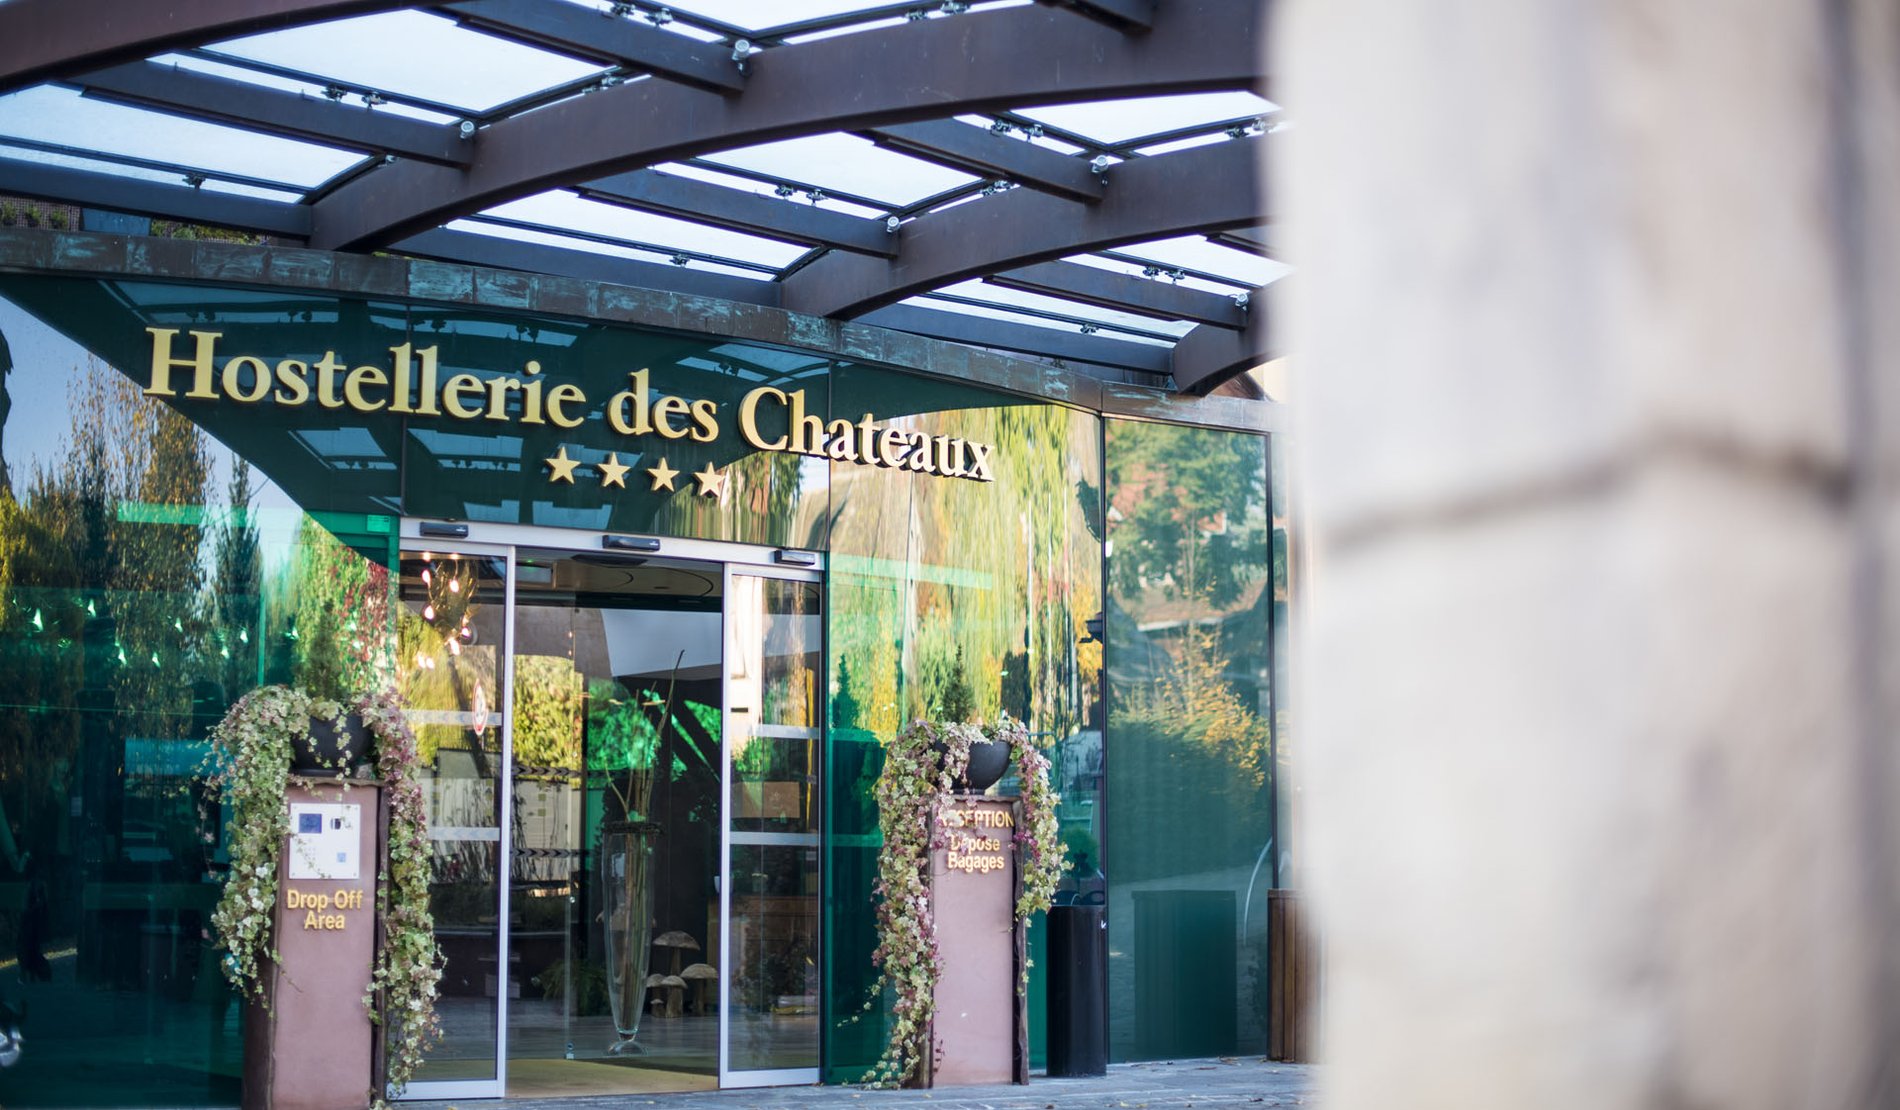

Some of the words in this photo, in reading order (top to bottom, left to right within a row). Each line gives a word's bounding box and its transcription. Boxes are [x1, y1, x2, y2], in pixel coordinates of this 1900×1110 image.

[143, 327, 587, 428] Hostellerie
[607, 367, 719, 443] des
[738, 386, 996, 483] Chateaux
[950, 834, 1001, 855] Dpose
[948, 851, 1005, 873] Bagages
[287, 888, 328, 913] Drop
[334, 889, 363, 909] Off
[304, 910, 345, 930] Area
